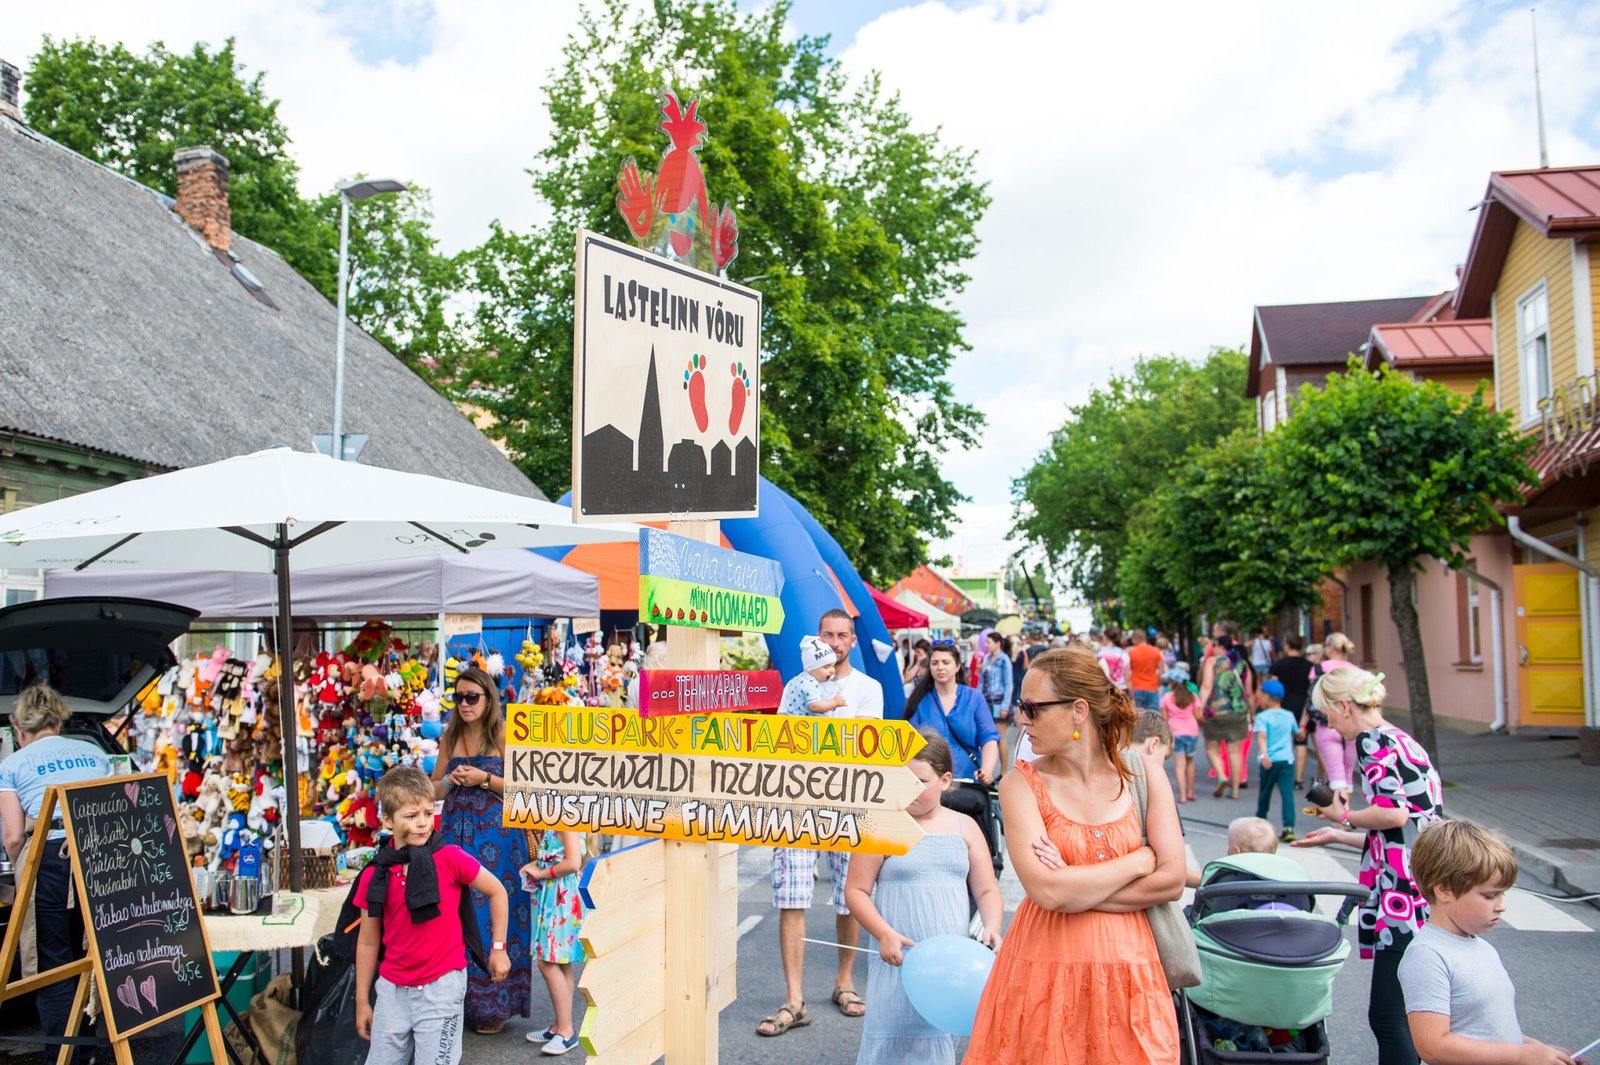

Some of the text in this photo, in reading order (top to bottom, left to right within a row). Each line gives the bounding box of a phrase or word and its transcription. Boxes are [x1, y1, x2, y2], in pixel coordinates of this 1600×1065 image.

[604, 274, 744, 348] LASTELINN VÕRU
[709, 591, 768, 627] LOOMAAED
[811, 640, 821, 652] I
[676, 673, 749, 712] TEHNIKAPARK
[691, 715, 915, 763] FANTAASIAHOOV
[37, 754, 97, 776] estonia
[512, 750, 886, 804] KREUTZWALDI MUUSEUM
[143, 813, 162, 833] 3€
[508, 788, 863, 848] MÜSTILINE FILMIMAJA
[148, 841, 167, 859] 3€
